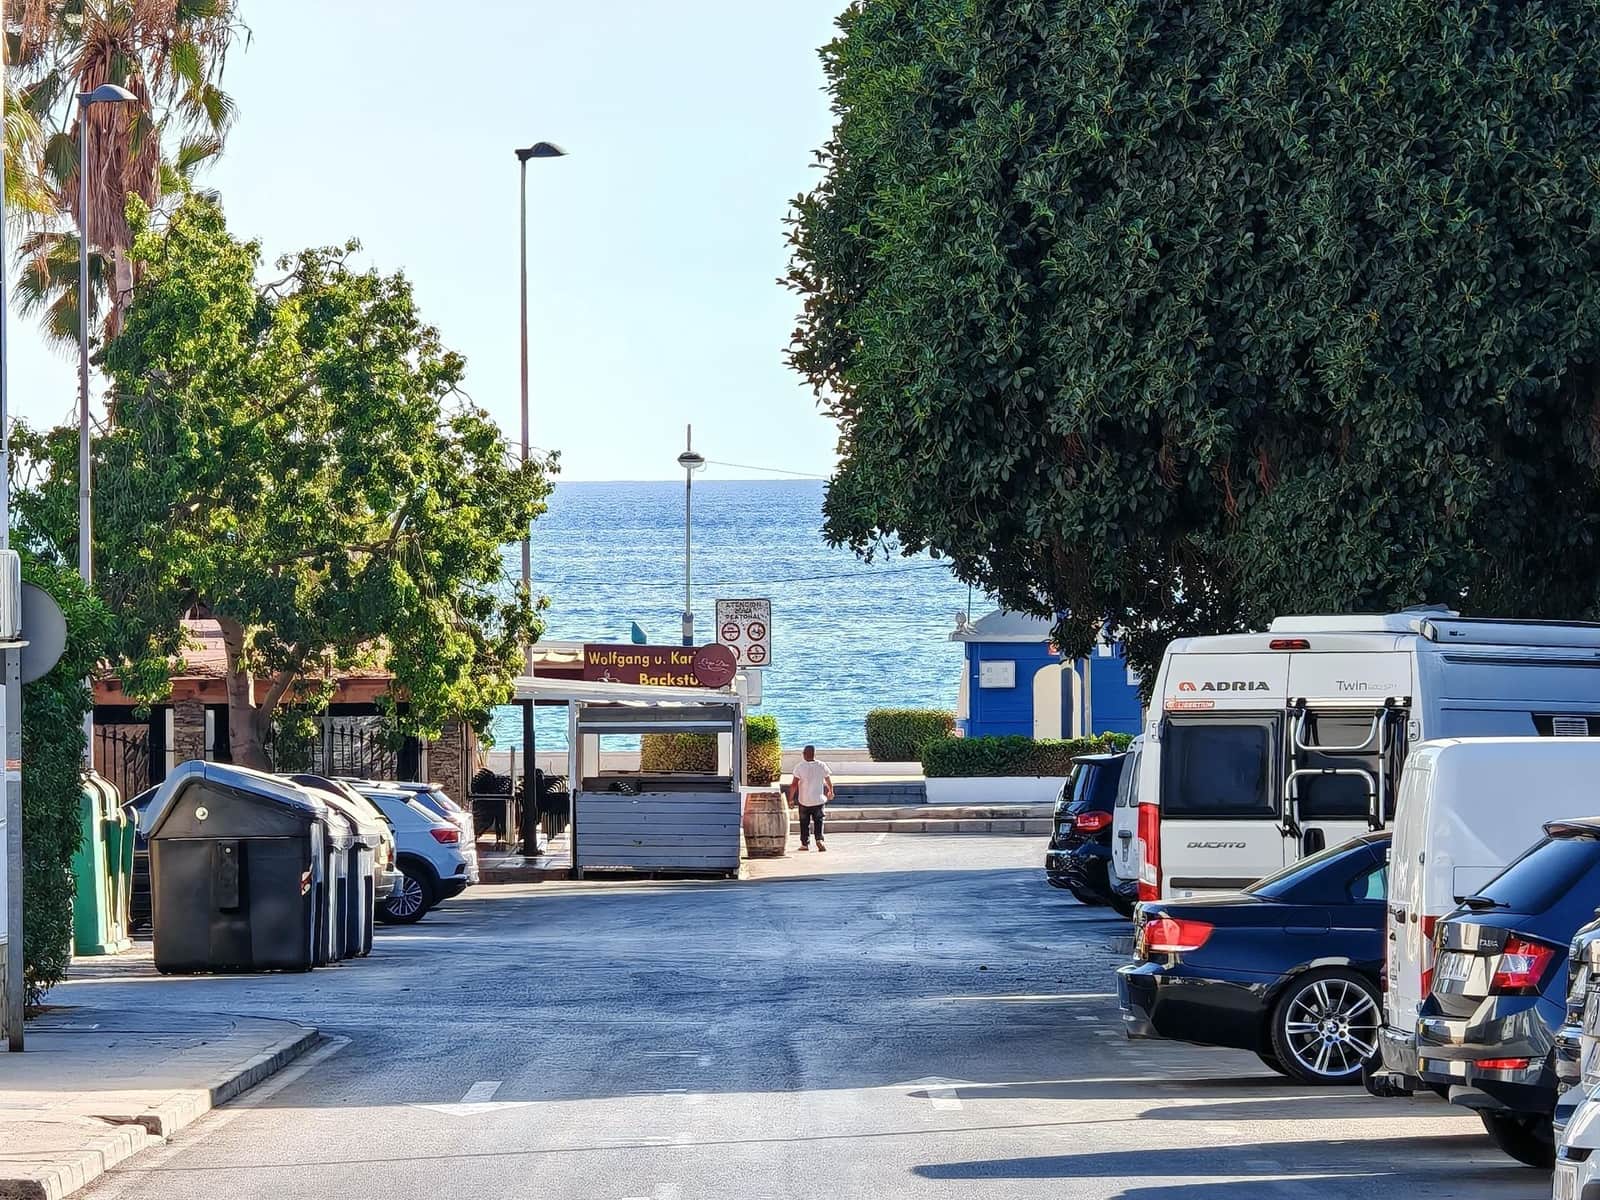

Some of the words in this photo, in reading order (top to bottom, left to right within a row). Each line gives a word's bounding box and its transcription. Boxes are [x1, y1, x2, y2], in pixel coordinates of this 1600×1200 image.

[588, 651, 650, 668] Wolfgang
[654, 656, 666, 665] u.
[671, 651, 697, 665] Kar
[639, 672, 703, 686] Backstü
[1201, 681, 1270, 691] ADRIA
[1335, 680, 1368, 691] Twin
[1186, 841, 1247, 849] DUCATO
